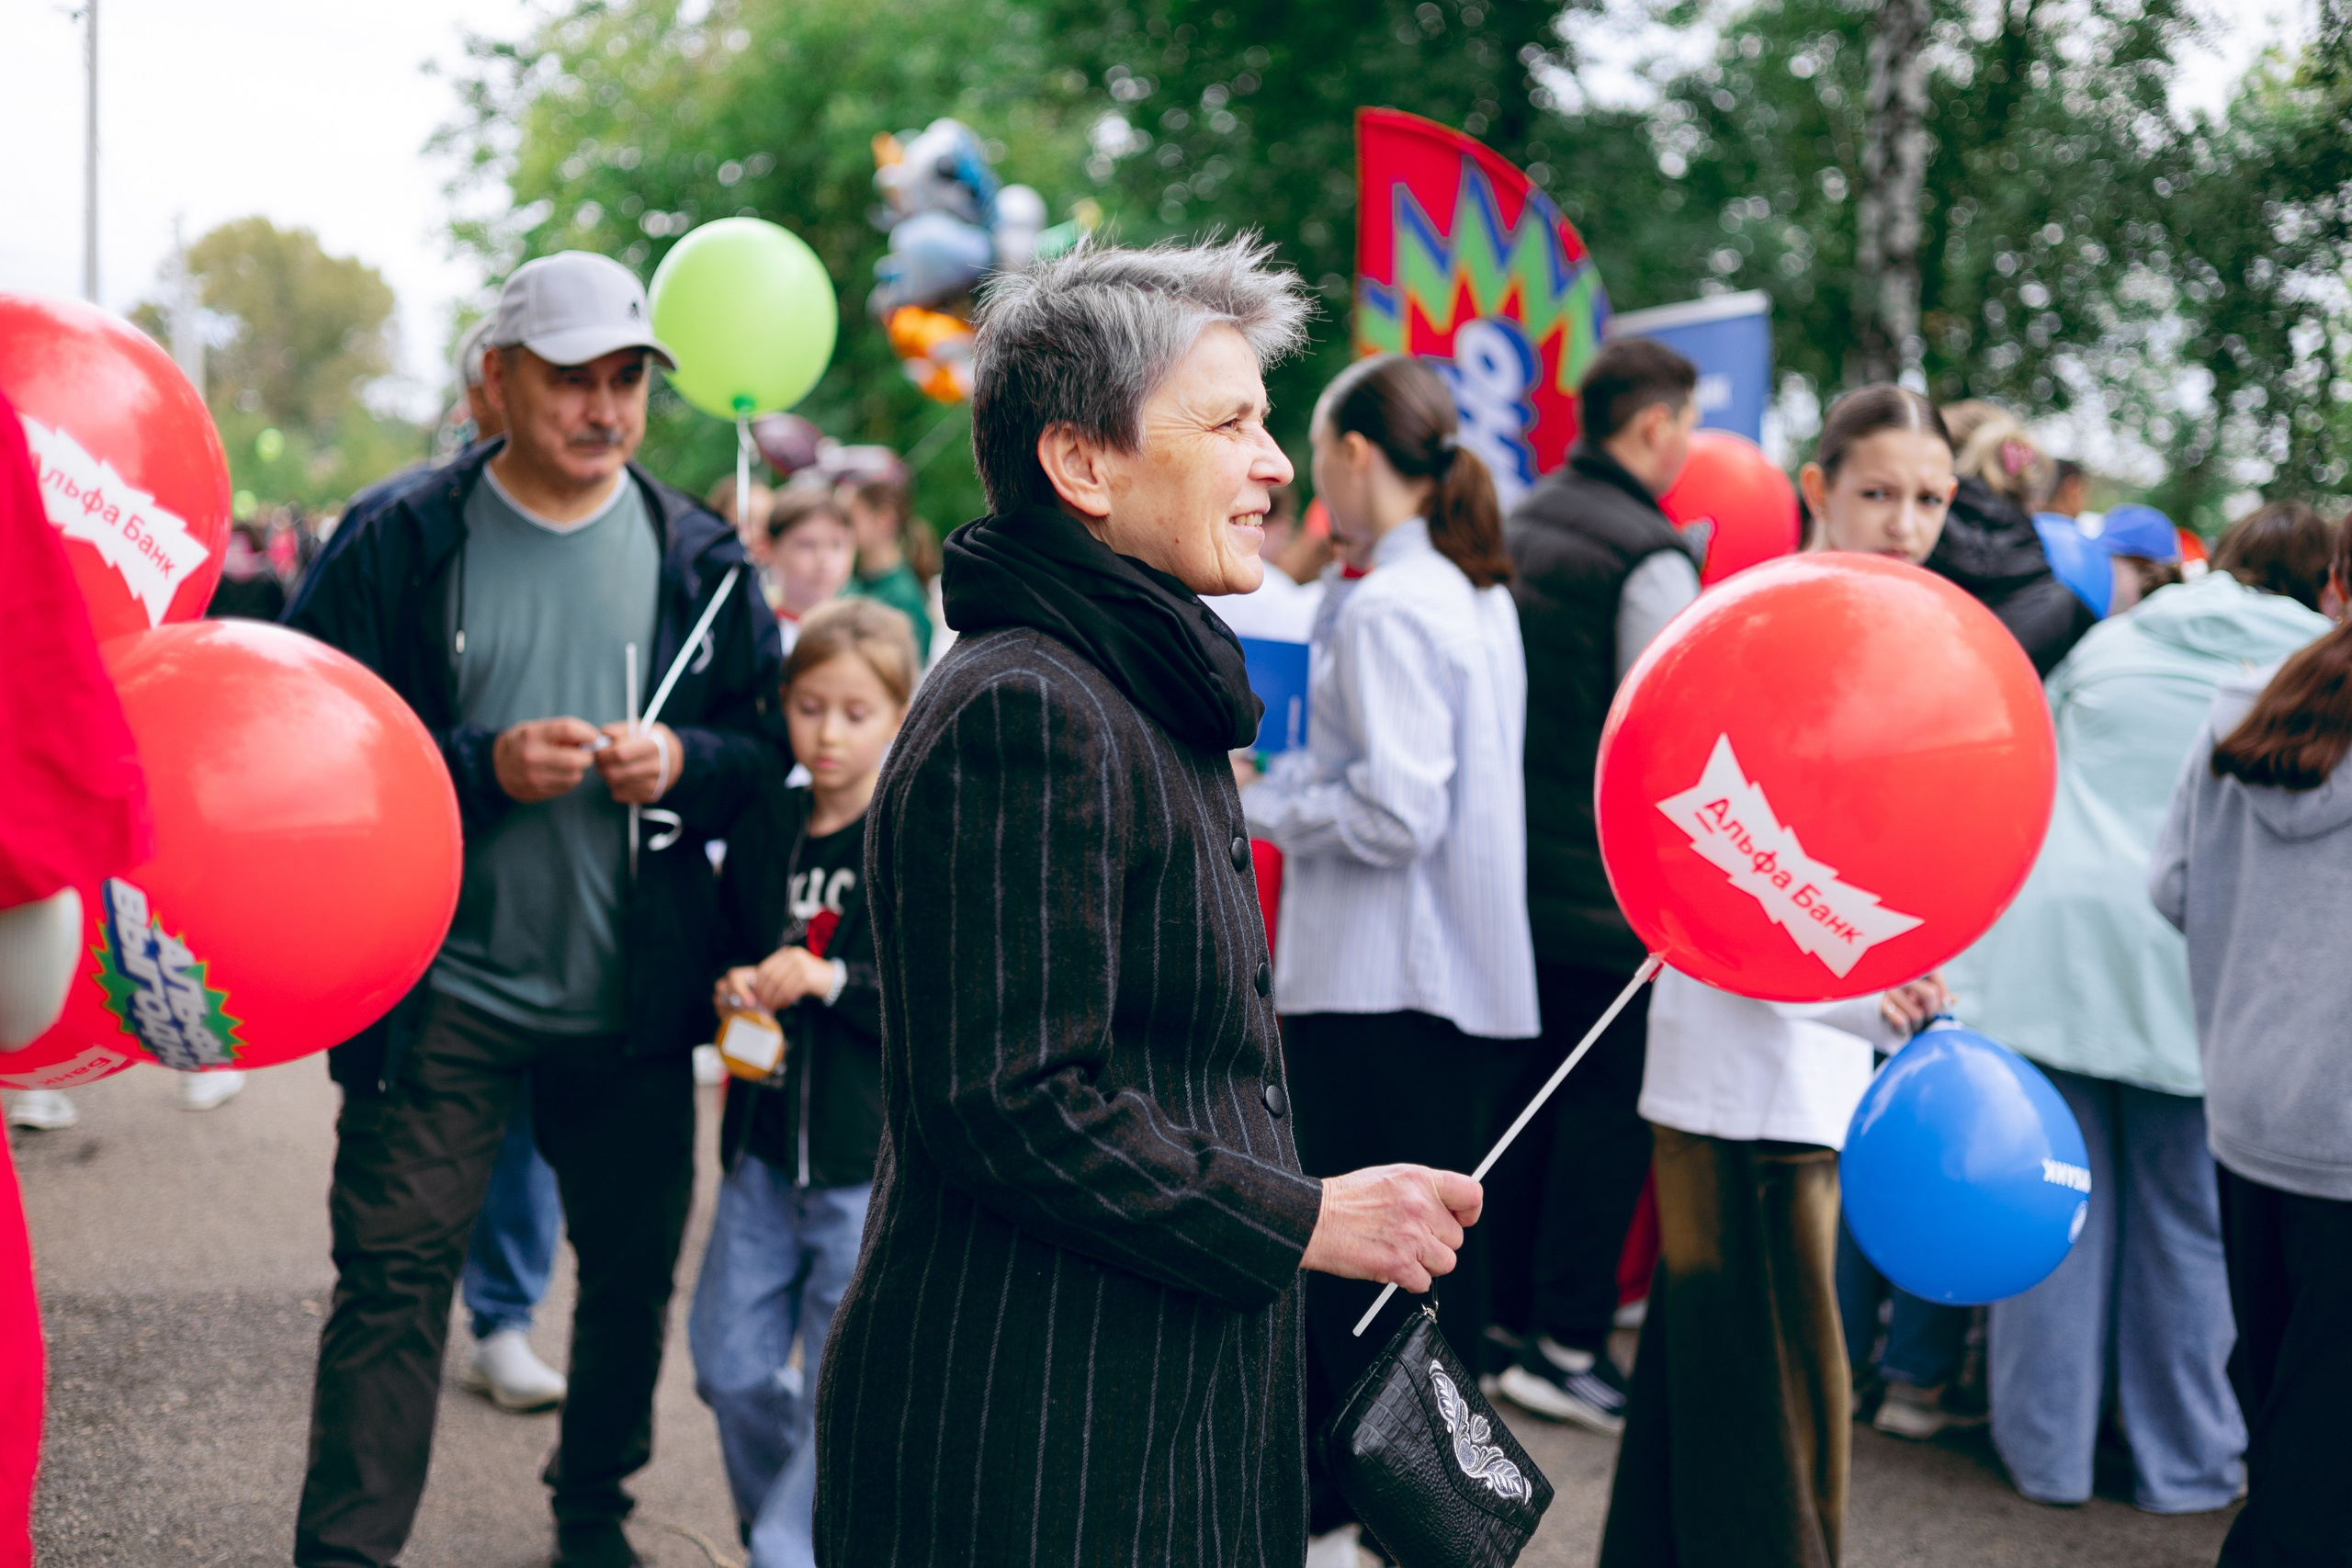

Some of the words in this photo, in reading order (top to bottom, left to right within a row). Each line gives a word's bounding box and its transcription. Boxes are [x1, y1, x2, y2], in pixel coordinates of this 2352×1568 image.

[39, 467, 120, 525] льфа
[120, 512, 177, 580] Банк
[1696, 796, 1792, 890] Альфа
[1790, 882, 1866, 946] Банк
